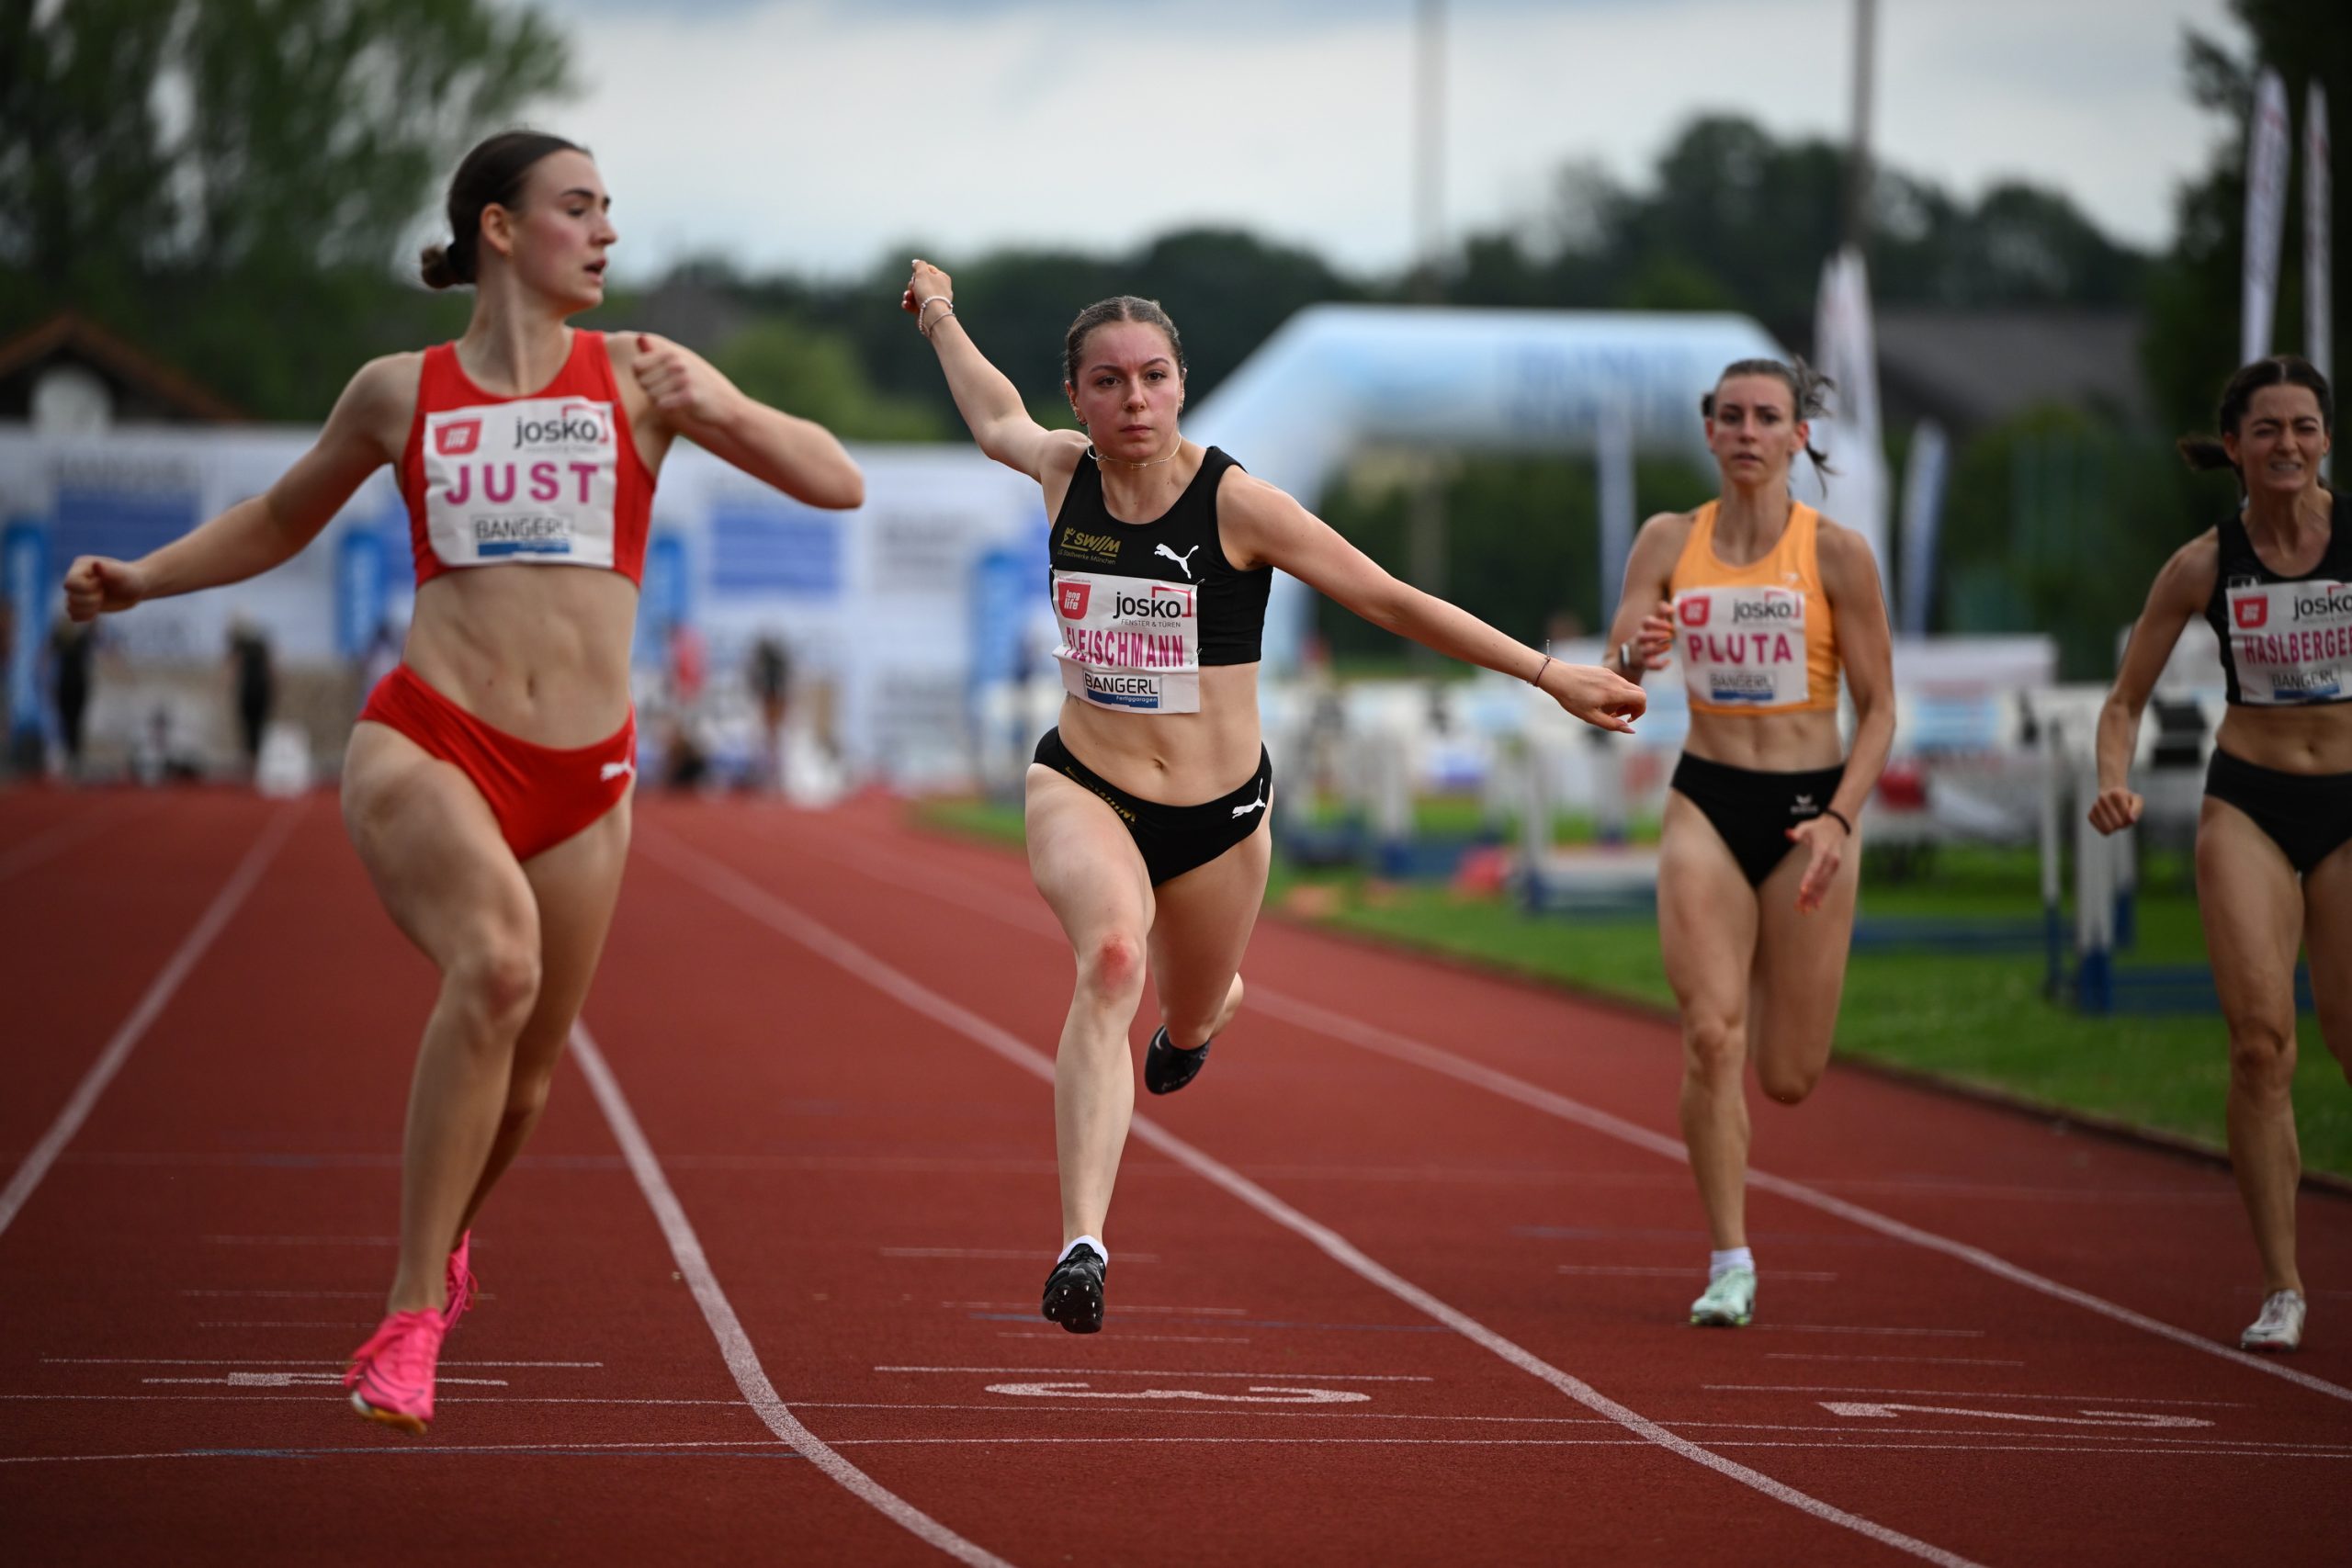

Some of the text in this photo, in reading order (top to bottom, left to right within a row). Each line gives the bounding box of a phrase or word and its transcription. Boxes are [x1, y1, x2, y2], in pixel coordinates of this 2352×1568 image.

[514, 416, 598, 449] josko
[445, 462, 598, 504] JUST
[1064, 599, 1079, 610] life
[1066, 590, 1080, 600] long
[1113, 592, 1181, 619] josko
[1121, 619, 1150, 627] FENSTER
[1065, 626, 1183, 668] FLEISCHMANN
[1688, 633, 1792, 664] PLUTA
[2245, 626, 2352, 664] HASLBERGE
[1085, 672, 1158, 694] BANGERL
